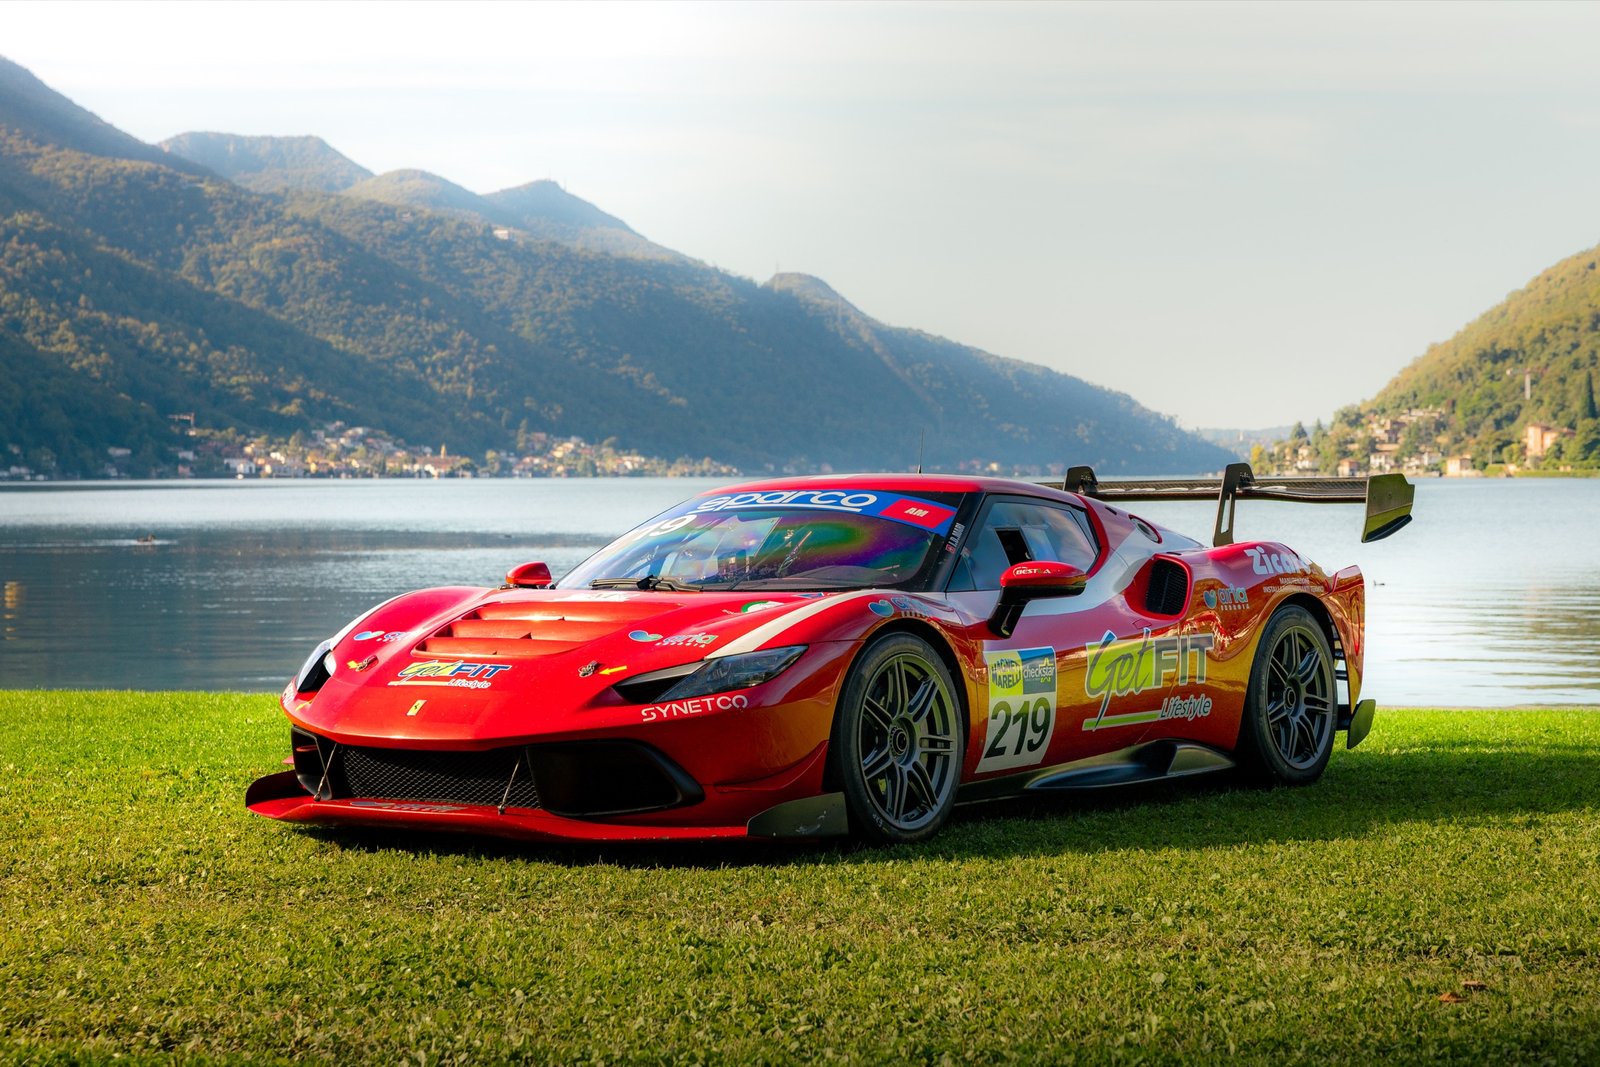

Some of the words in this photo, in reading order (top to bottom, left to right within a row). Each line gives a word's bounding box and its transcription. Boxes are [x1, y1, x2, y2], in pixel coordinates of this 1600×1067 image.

[696, 490, 878, 511] sparco
[904, 507, 930, 518] AM
[1023, 666, 1055, 678] checkstar
[641, 694, 748, 722] SYNETCO
[1160, 696, 1212, 720] Lifestyle
[984, 697, 1051, 760] 219
